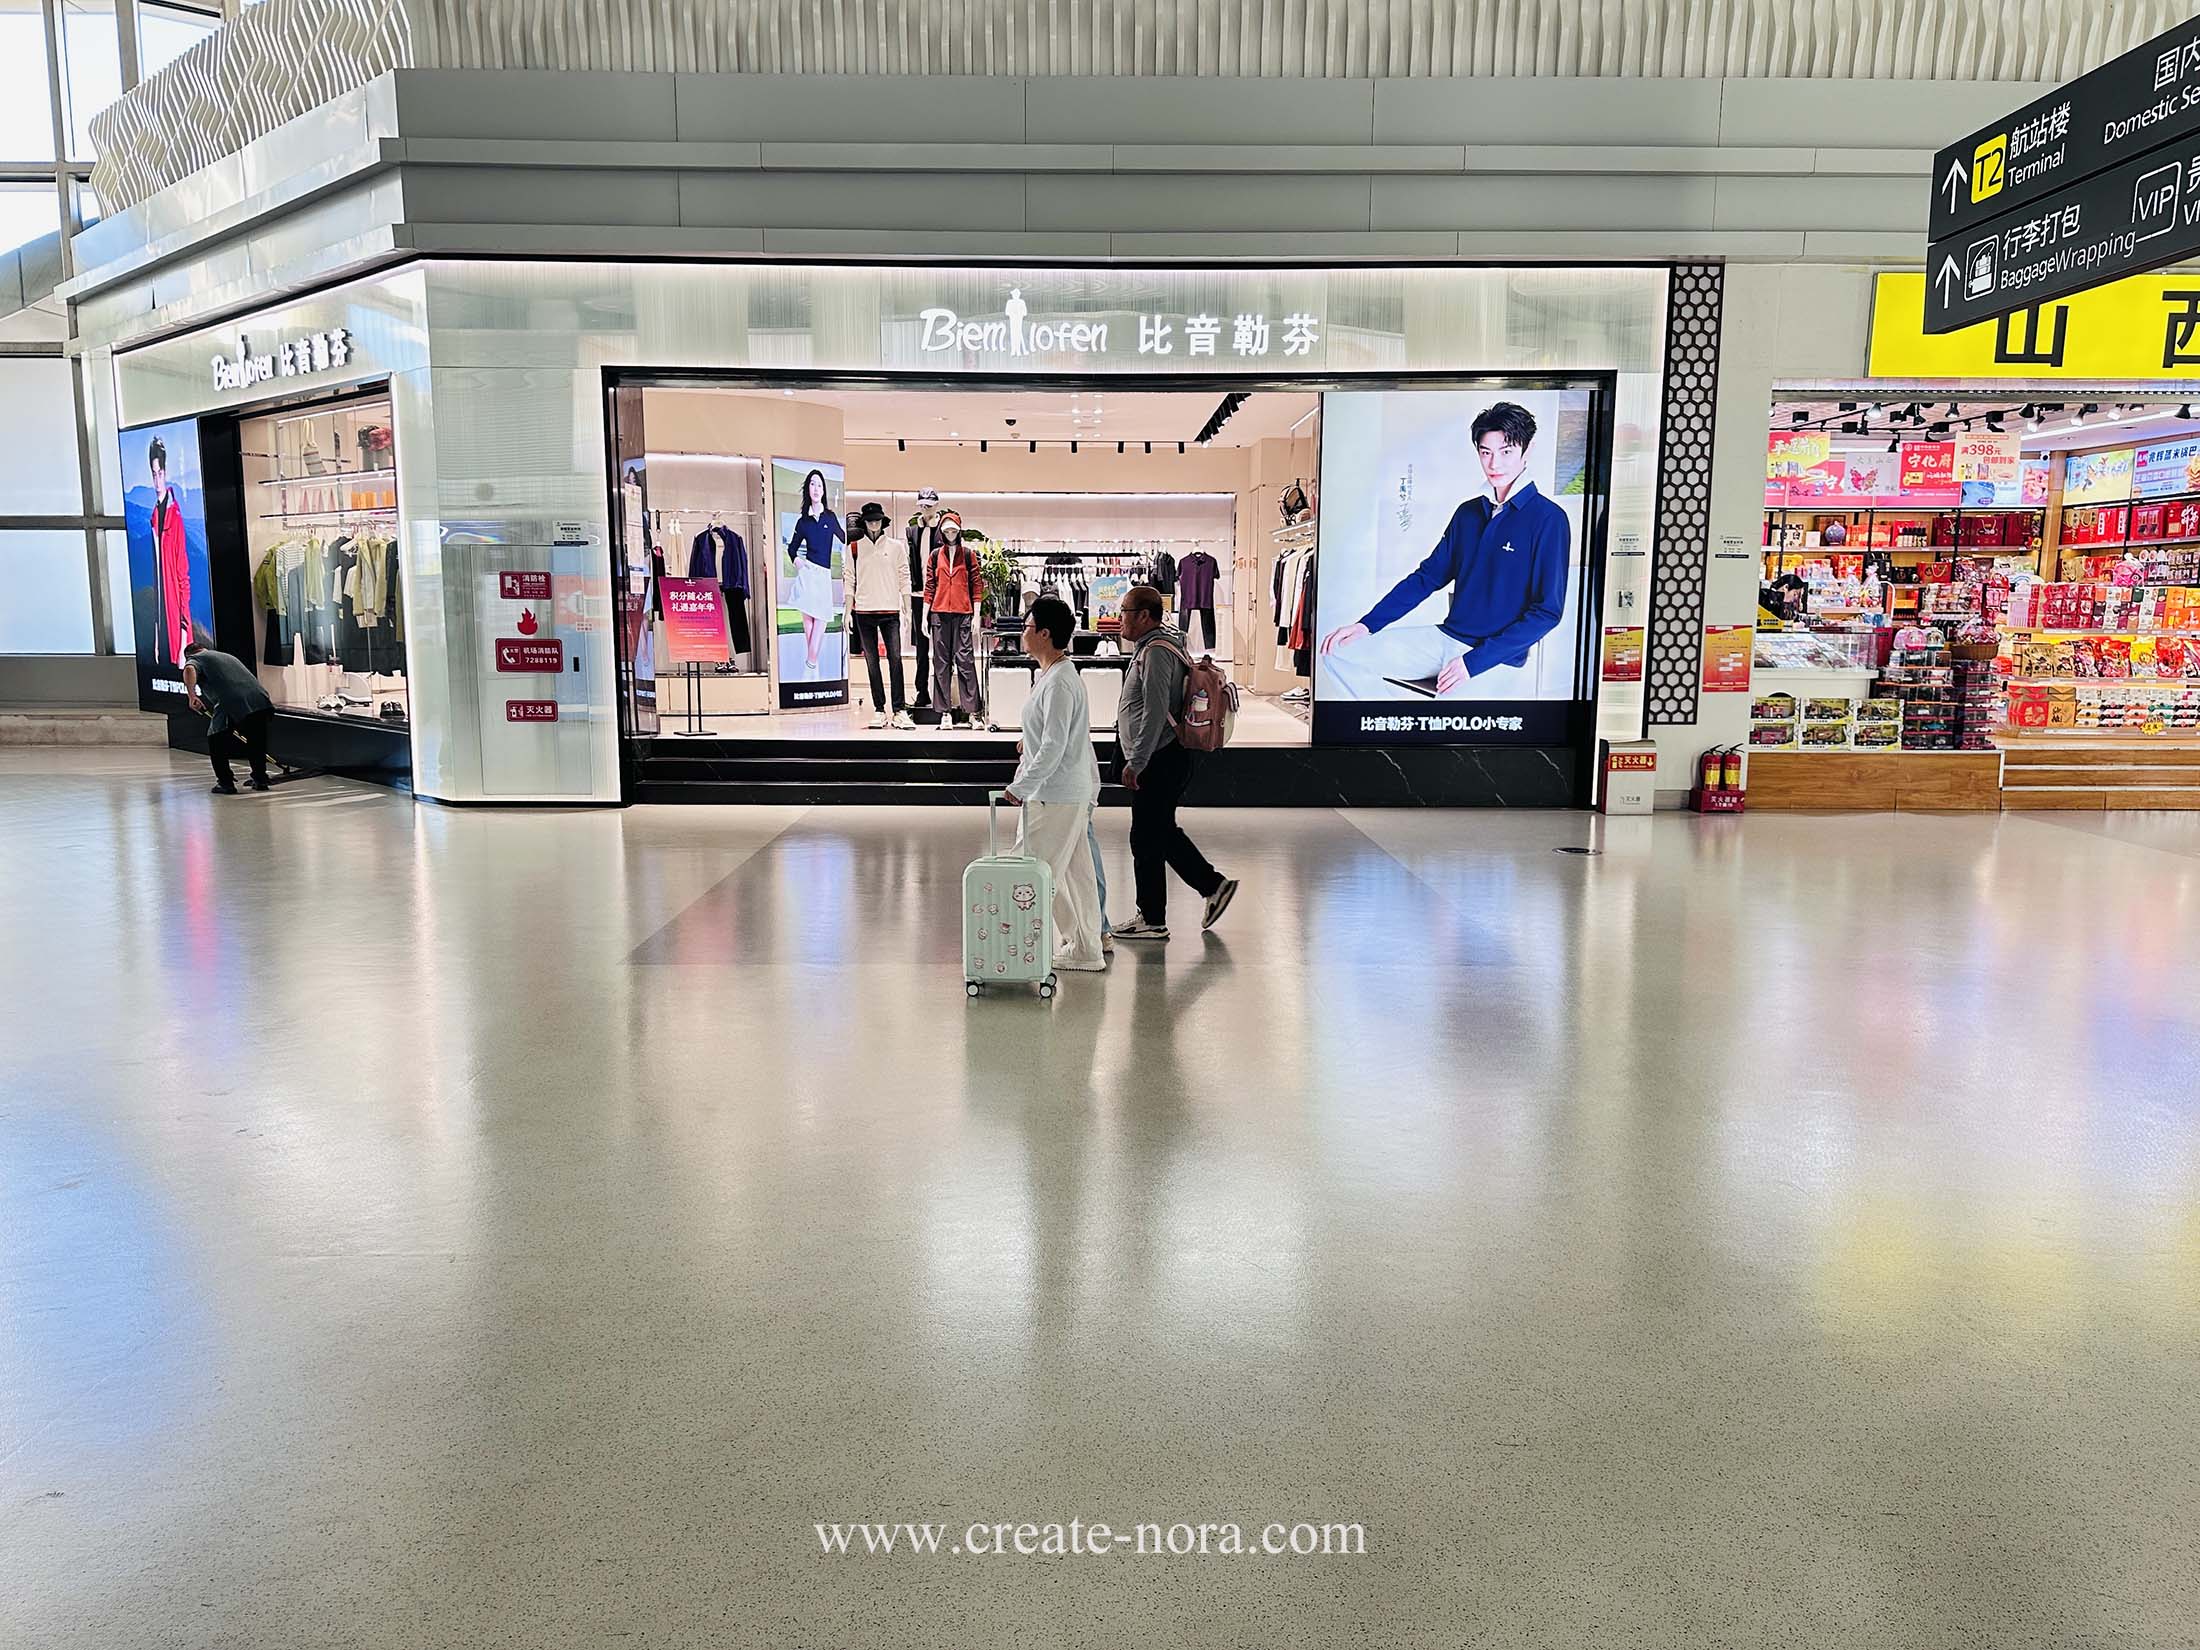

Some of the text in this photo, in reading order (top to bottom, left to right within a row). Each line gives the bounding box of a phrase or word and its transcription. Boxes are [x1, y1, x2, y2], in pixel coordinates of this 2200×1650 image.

[2009, 101, 2072, 160] 航站楼
[2103, 95, 2178, 145] Domestic
[1975, 147, 2004, 193] T2
[2008, 144, 2065, 188] Terminal
[2138, 184, 2174, 221] VIP
[2003, 204, 2081, 261] 行李打包
[2000, 230, 2136, 289] BaggageWrapping
[1139, 313, 1320, 356] 比音勒芬
[522, 574, 546, 583] 消防栓
[669, 591, 714, 601] 积分随心抵
[526, 705, 553, 714] 灭火器
[1624, 755, 1647, 765] 灭火器
